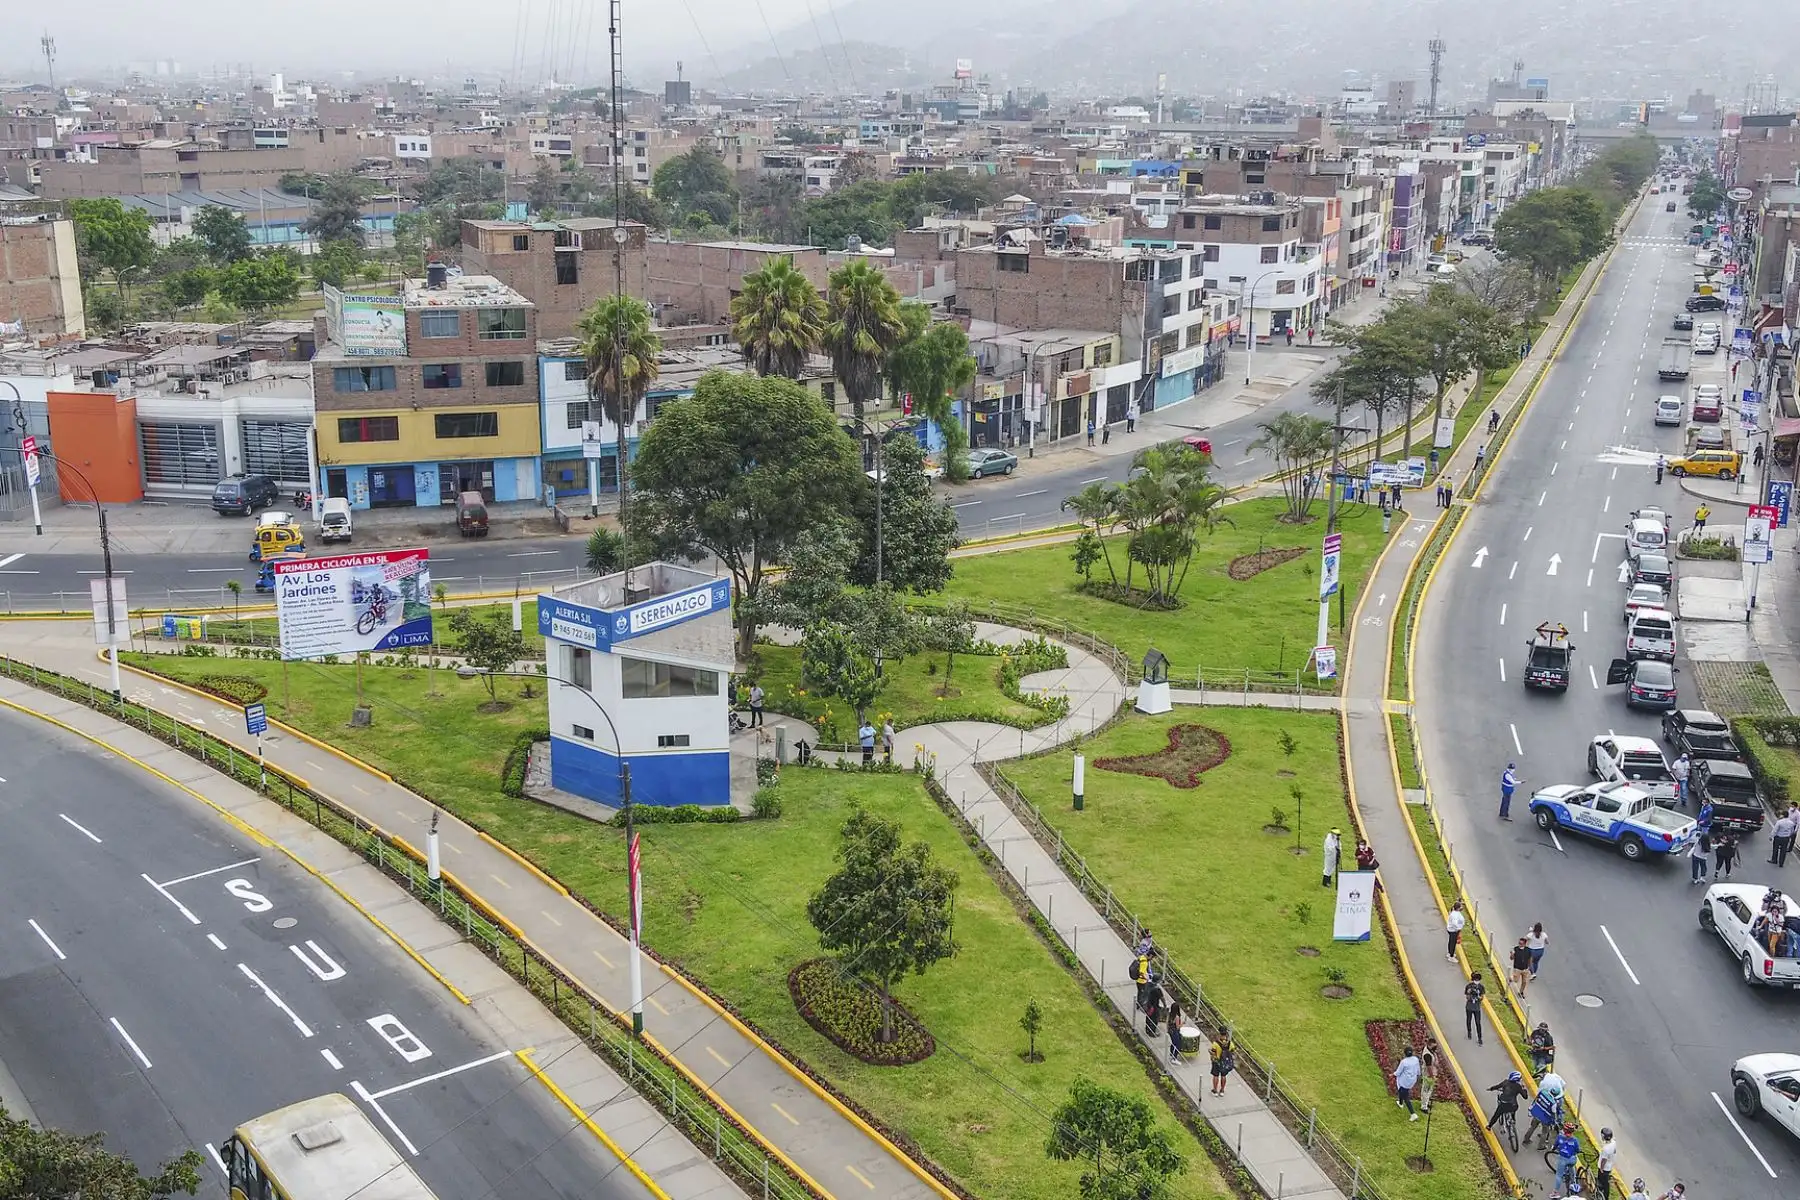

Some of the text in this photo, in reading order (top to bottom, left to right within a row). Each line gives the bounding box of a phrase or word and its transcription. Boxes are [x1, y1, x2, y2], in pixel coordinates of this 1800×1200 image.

[280, 555, 389, 573] PRIMERA CICLOVÍA EN SJL
[281, 573, 331, 586] Av. Los
[282, 584, 337, 599] Jardines
[555, 606, 593, 624] ALERTA SJL
[641, 594, 707, 624] SERENAZGO
[404, 634, 429, 644] LIMA
[572, 627, 583, 639] 722
